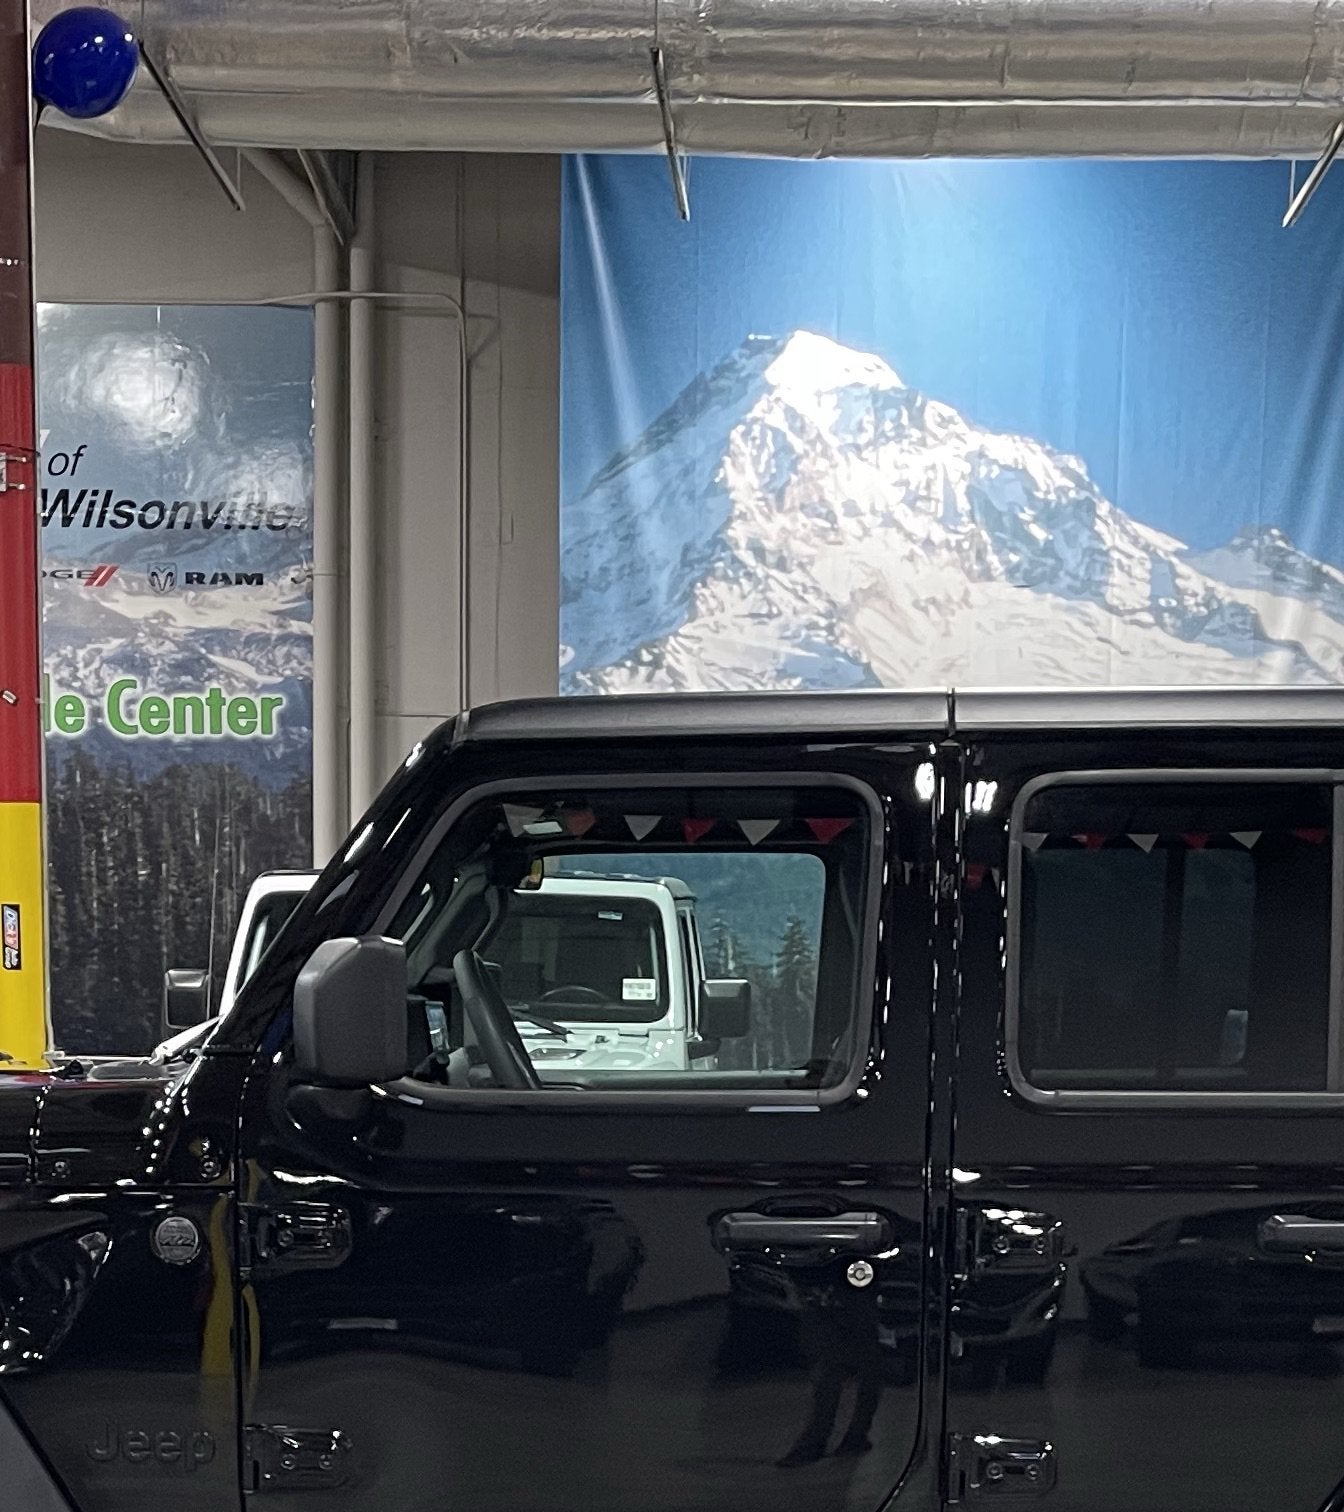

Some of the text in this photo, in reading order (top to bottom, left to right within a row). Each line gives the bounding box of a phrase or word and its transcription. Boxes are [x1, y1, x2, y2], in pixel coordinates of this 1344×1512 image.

[47, 445, 88, 476] of
[41, 488, 295, 531] Wilsonville
[185, 571, 264, 586] RAM
[107, 678, 283, 735] Center
[86, 1418, 215, 1472] Jeep
